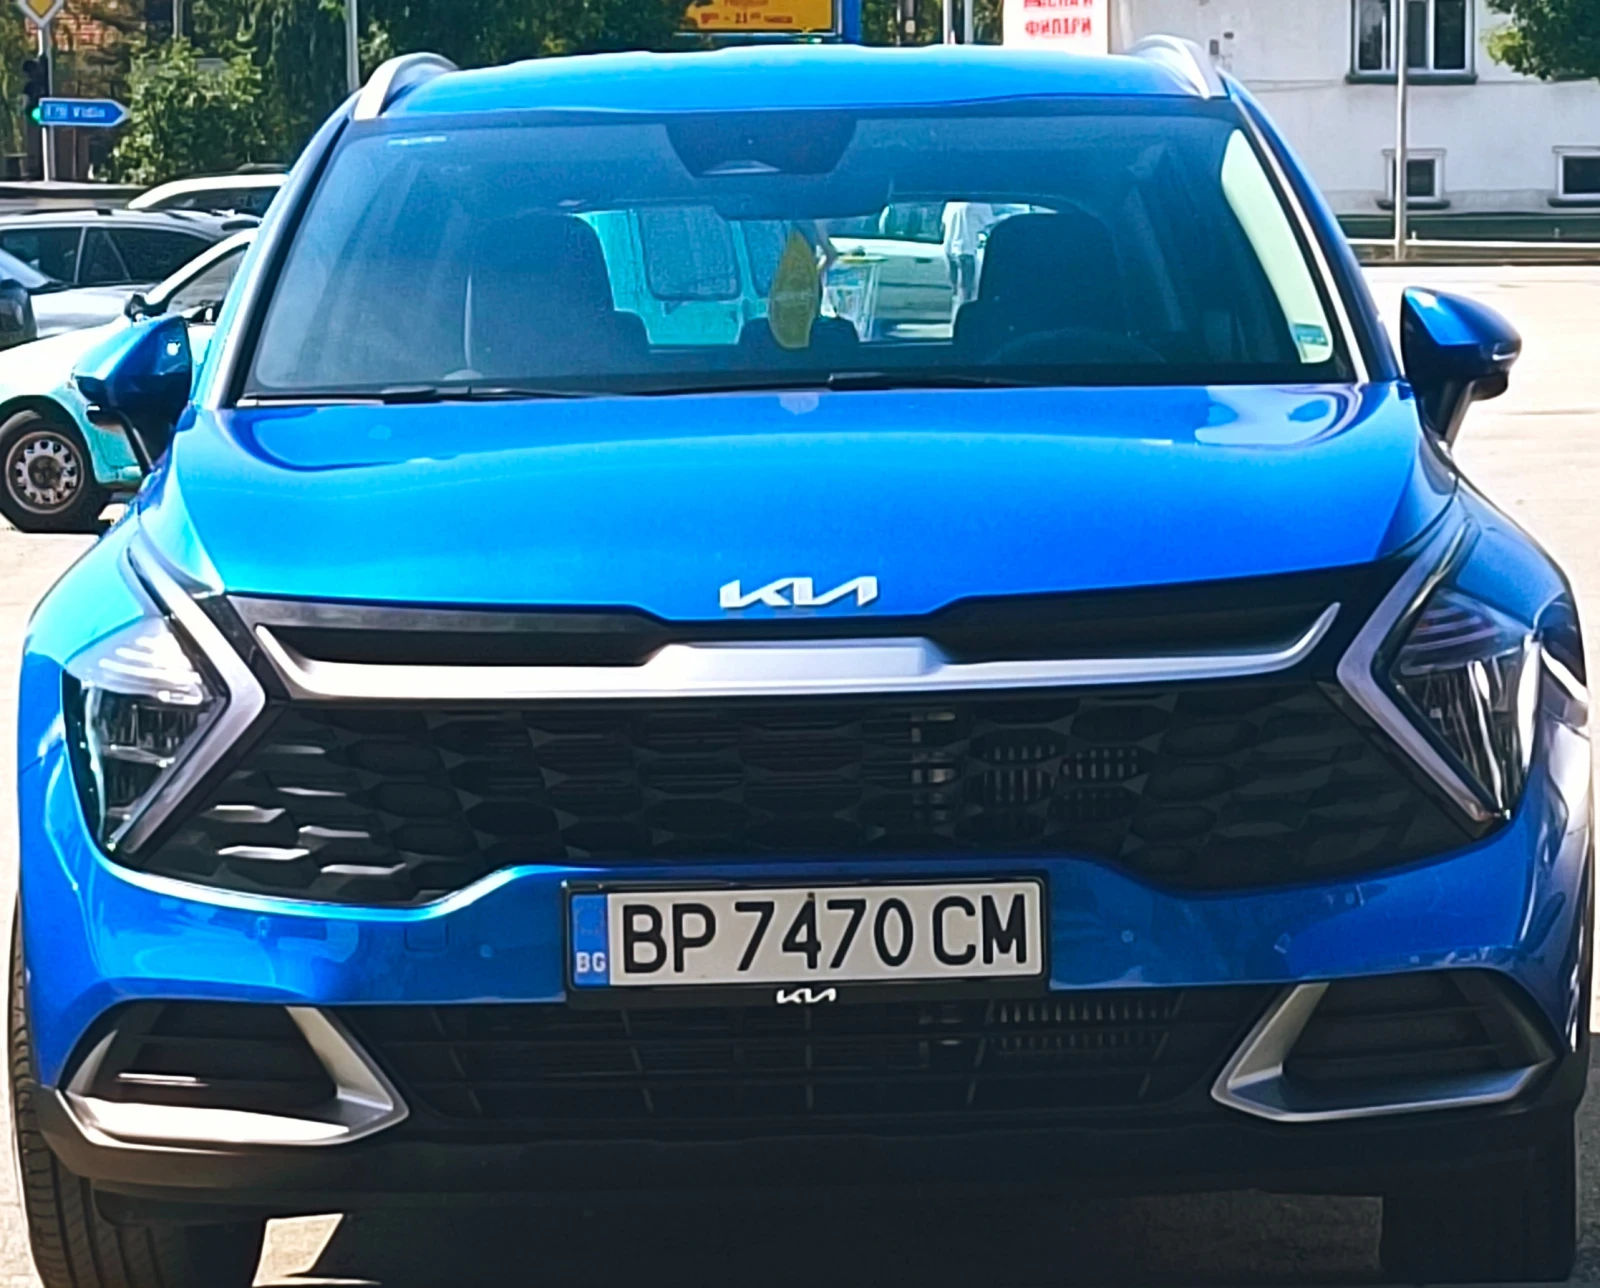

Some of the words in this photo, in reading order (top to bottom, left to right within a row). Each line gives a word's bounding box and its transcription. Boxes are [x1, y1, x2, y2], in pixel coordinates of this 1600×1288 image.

[622, 902, 716, 974] BP
[734, 897, 914, 972] 7470
[931, 893, 1027, 967] CM
[575, 951, 607, 974] BG
